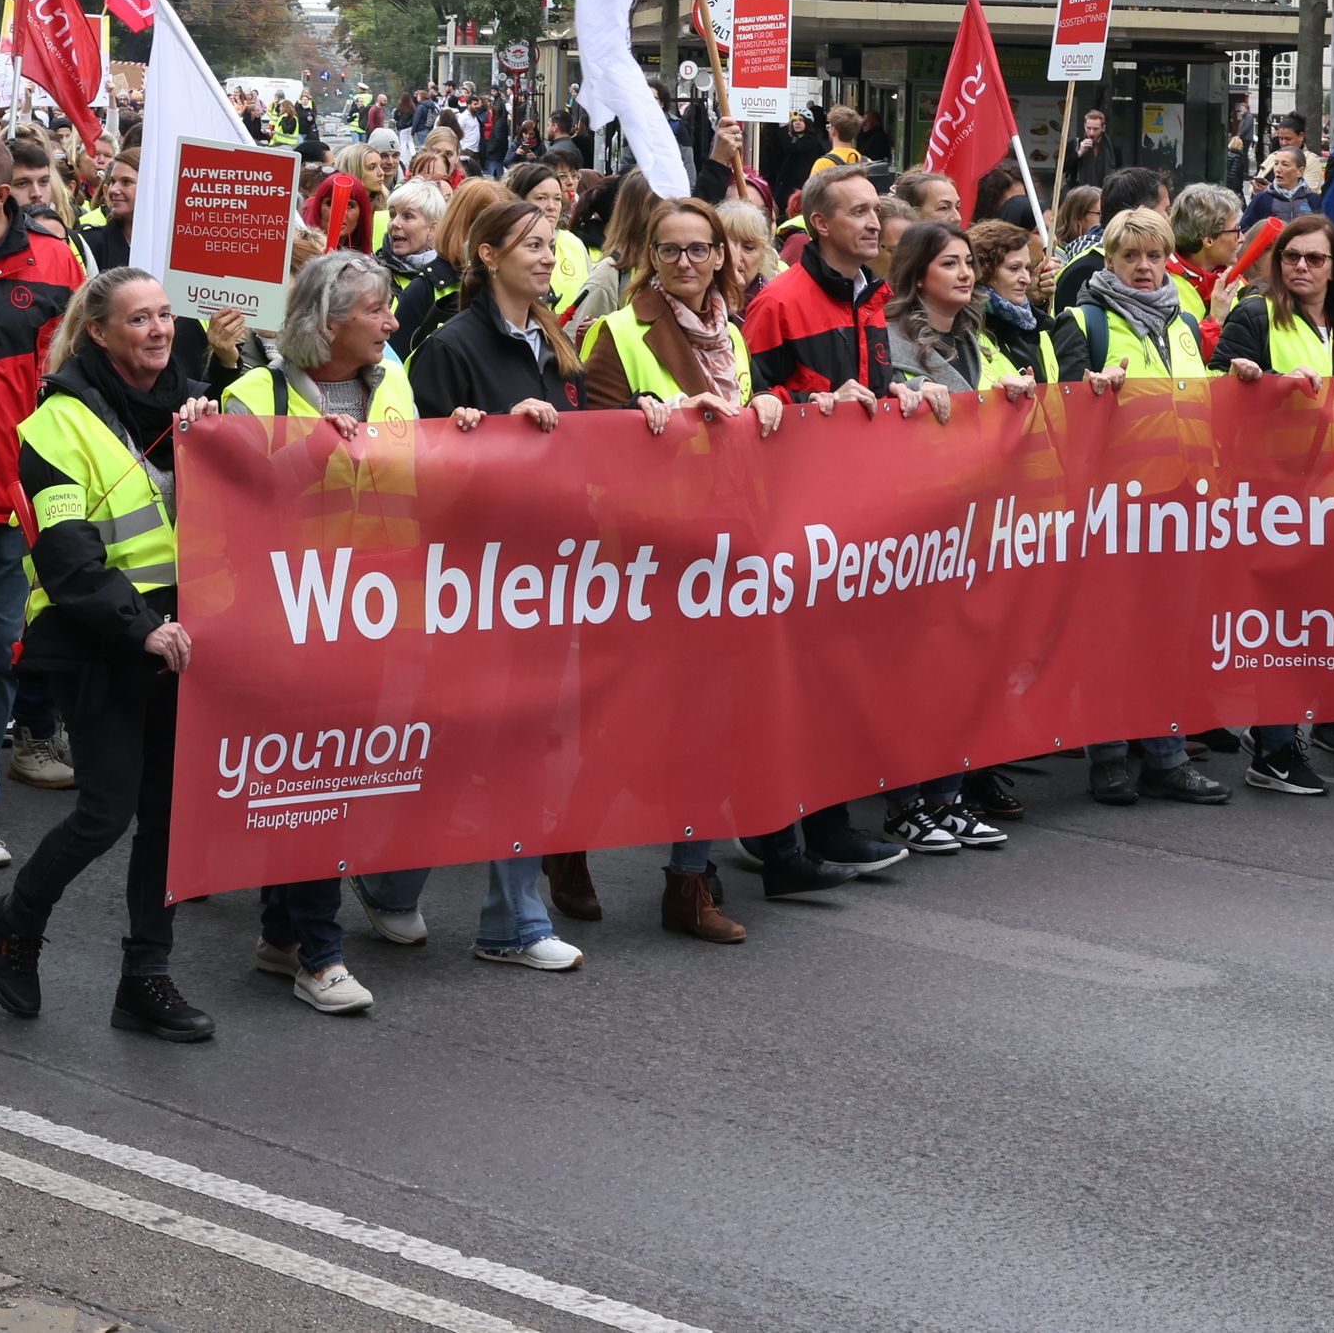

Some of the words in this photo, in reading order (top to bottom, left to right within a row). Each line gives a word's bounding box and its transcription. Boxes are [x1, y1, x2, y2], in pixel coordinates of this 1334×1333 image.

[1085, 3, 1097, 13] DER
[734, 16, 756, 24] AUSBAU
[756, 15, 768, 23] VON
[768, 14, 786, 22] MULTI-
[738, 22, 787, 32] PROFESSIONELLEN
[736, 32, 754, 41] TEAMS
[765, 31, 774, 39] DIE
[744, 57, 752, 65] IN
[752, 56, 763, 64] DER
[762, 55, 780, 64] ARBEIT
[1061, 54, 1094, 69] younion
[740, 66, 750, 75] MIT
[751, 65, 762, 74] DEN
[762, 64, 786, 73] KINDERN
[741, 97, 777, 110] younion
[181, 167, 273, 182] AUFWERTUNG
[190, 182, 231, 195] ALLER
[234, 184, 292, 198] BERUFS-
[184, 196, 248, 210] GRUPPEN
[191, 211, 206, 223] IM
[208, 212, 290, 227] ELEMENTAR-
[176, 223, 286, 241] PÄDAGOGISCHEN
[204, 241, 260, 254] BEREICH
[187, 285, 260, 309] younion
[44, 502, 82, 521] younion
[270, 547, 399, 644] Wo
[424, 537, 659, 635] bleibt
[676, 532, 794, 619] das
[803, 502, 977, 608] Personal,
[986, 494, 1075, 573] Herr
[1234, 654, 1259, 669] Die
[217, 721, 432, 800] younion
[249, 781, 272, 797] Die
[275, 766, 424, 794] Daseinsgewerkschaft
[245, 806, 339, 831] Hauptgruppe
[341, 802, 349, 819] 1
